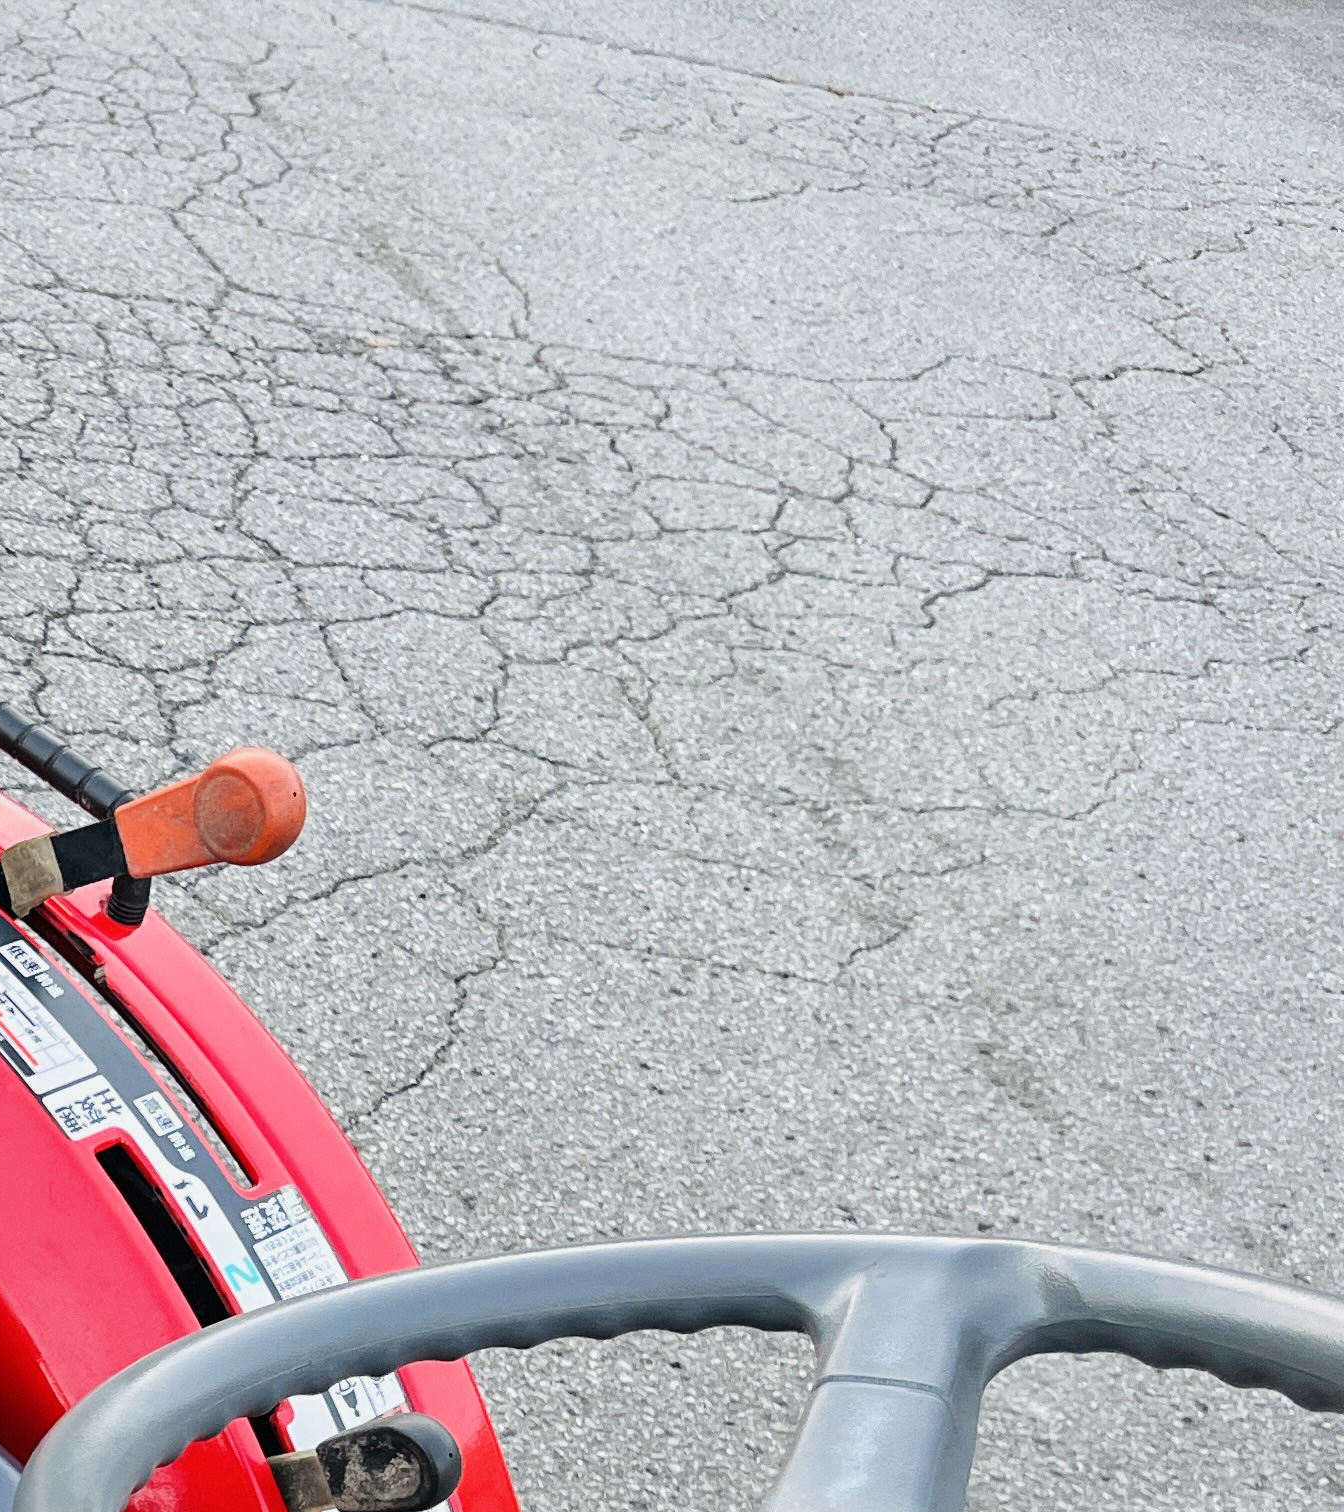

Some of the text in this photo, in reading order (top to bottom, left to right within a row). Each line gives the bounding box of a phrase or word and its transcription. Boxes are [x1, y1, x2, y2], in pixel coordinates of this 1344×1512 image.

[7, 944, 40, 974] 低速
[54, 1087, 122, 1134] 主変速
[184, 1195, 209, 1221] 1
[224, 1256, 262, 1293] N
